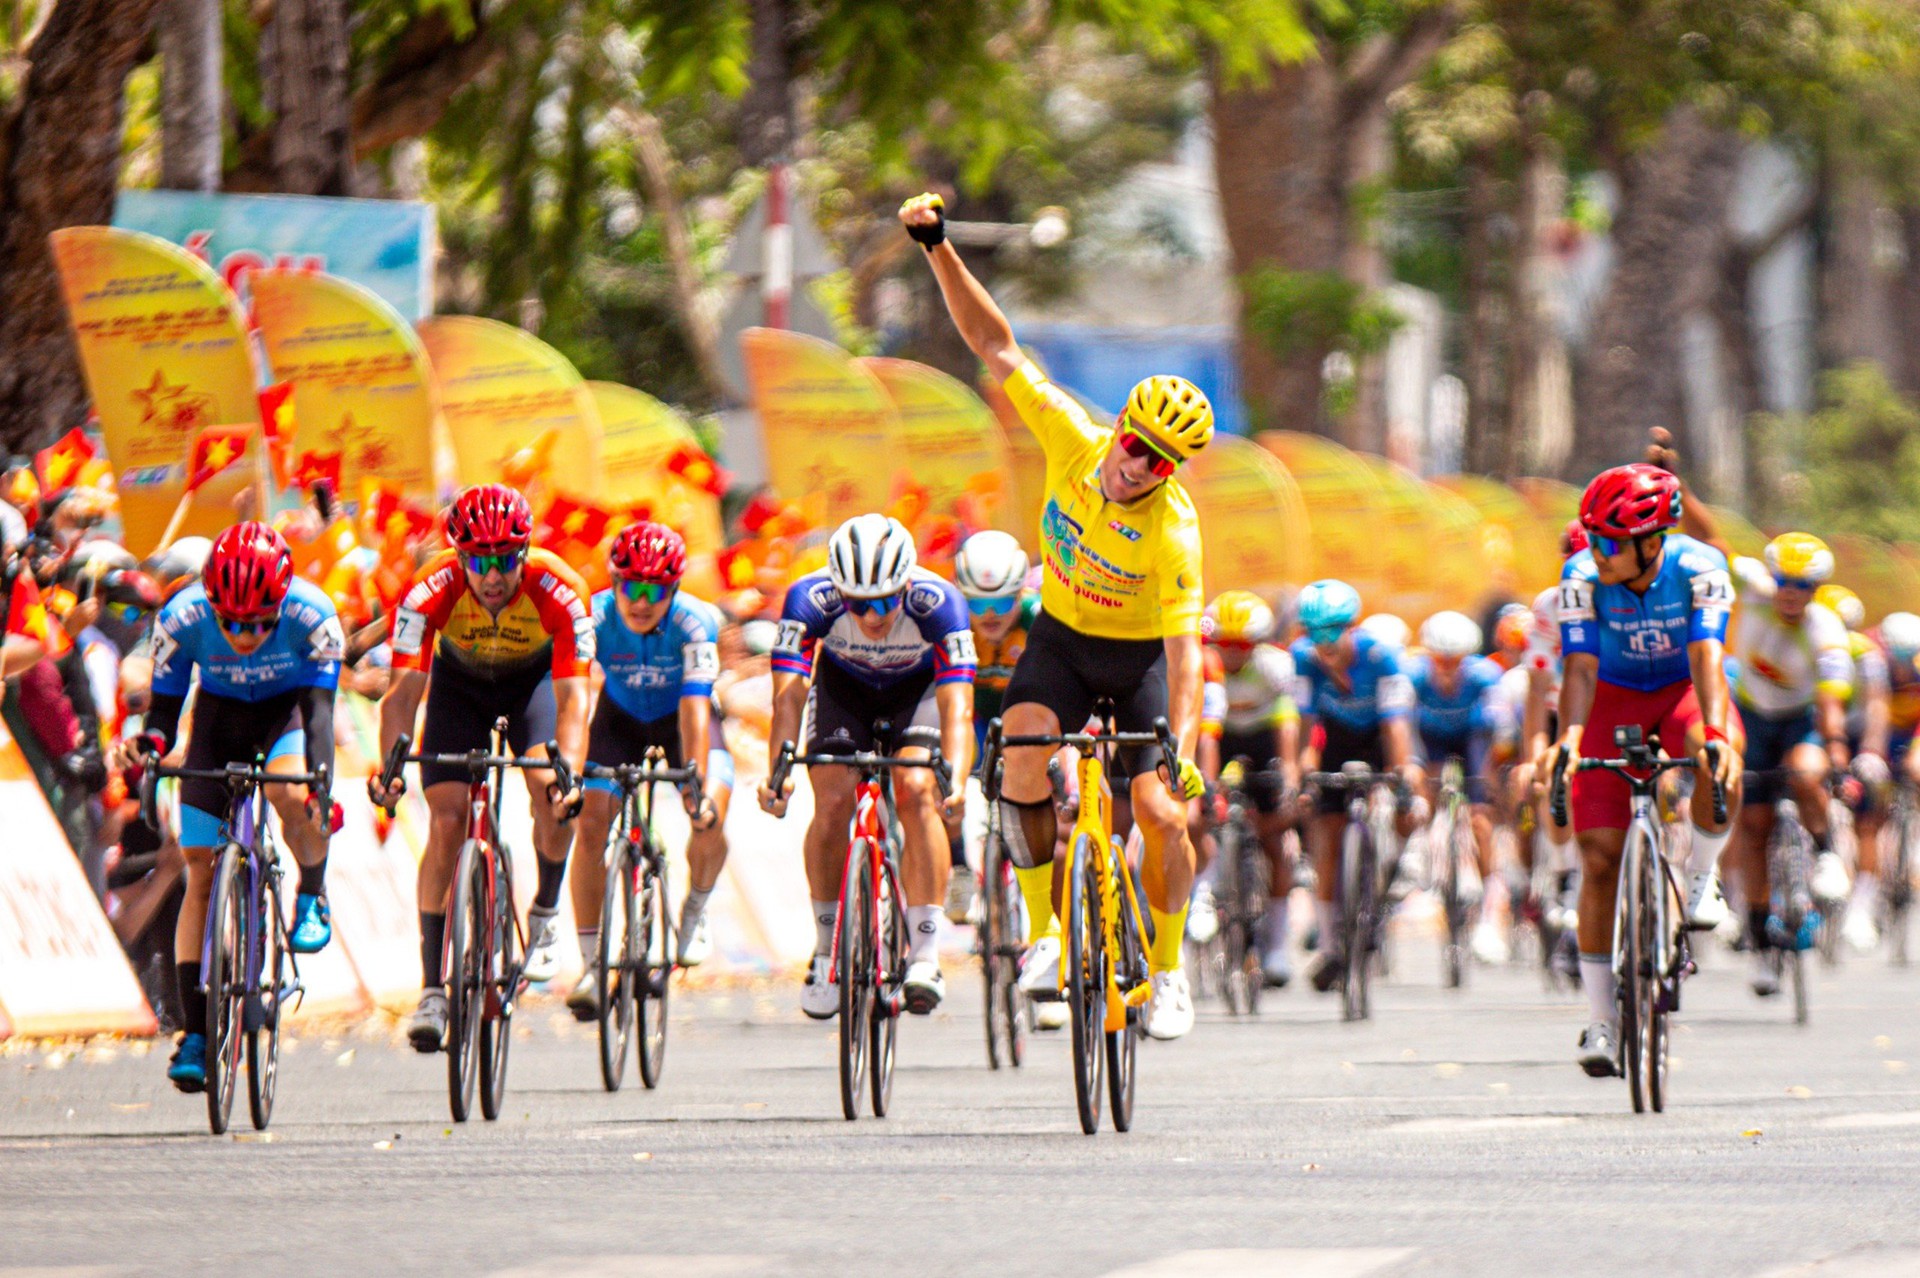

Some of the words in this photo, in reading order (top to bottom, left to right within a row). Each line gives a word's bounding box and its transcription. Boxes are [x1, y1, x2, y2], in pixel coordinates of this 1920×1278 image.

[1109, 520, 1142, 542] HTV
[427, 566, 454, 594] CITY
[1562, 587, 1583, 609] 11
[397, 615, 409, 639] 7
